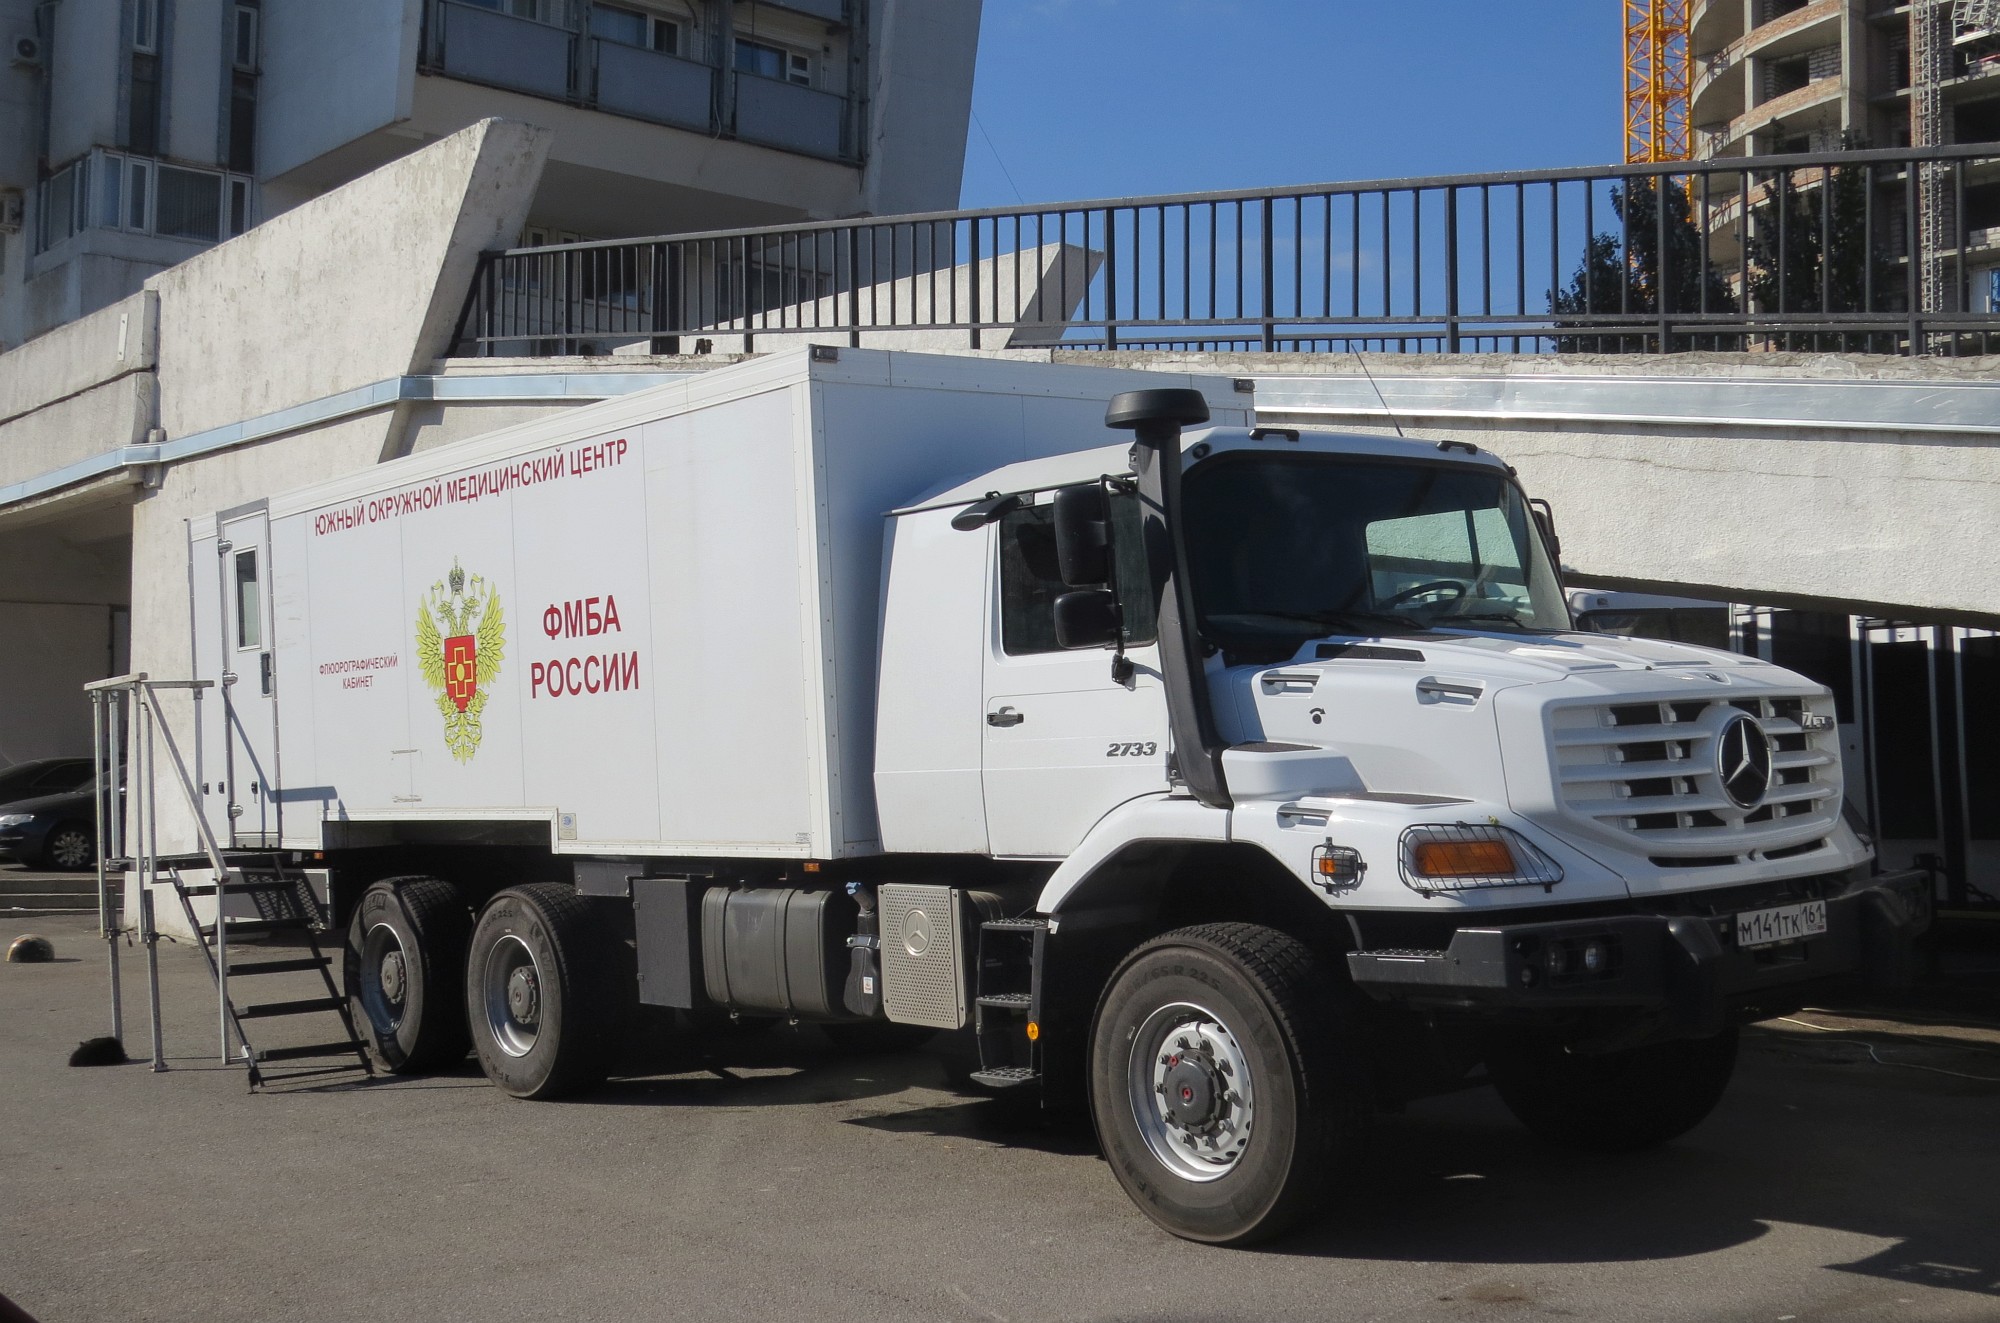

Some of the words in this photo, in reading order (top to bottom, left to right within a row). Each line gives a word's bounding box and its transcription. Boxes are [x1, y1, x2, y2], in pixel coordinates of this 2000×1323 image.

[315, 498, 365, 536] ЮЖНЫЙ
[368, 478, 443, 523] ОКРУЖНОЙ
[446, 448, 565, 504] МЕДИЦИНСКИЙ
[570, 438, 628, 479] ЦЕНТР
[543, 594, 621, 640] ФМБА
[319, 652, 398, 675] ФЛЮОРОГРАФИЧЕСКИЙ
[531, 651, 639, 699] РОССИИ
[342, 675, 373, 690] КАБИНЕТ
[1106, 741, 1157, 757] 2733
[1802, 903, 1823, 925] 161
